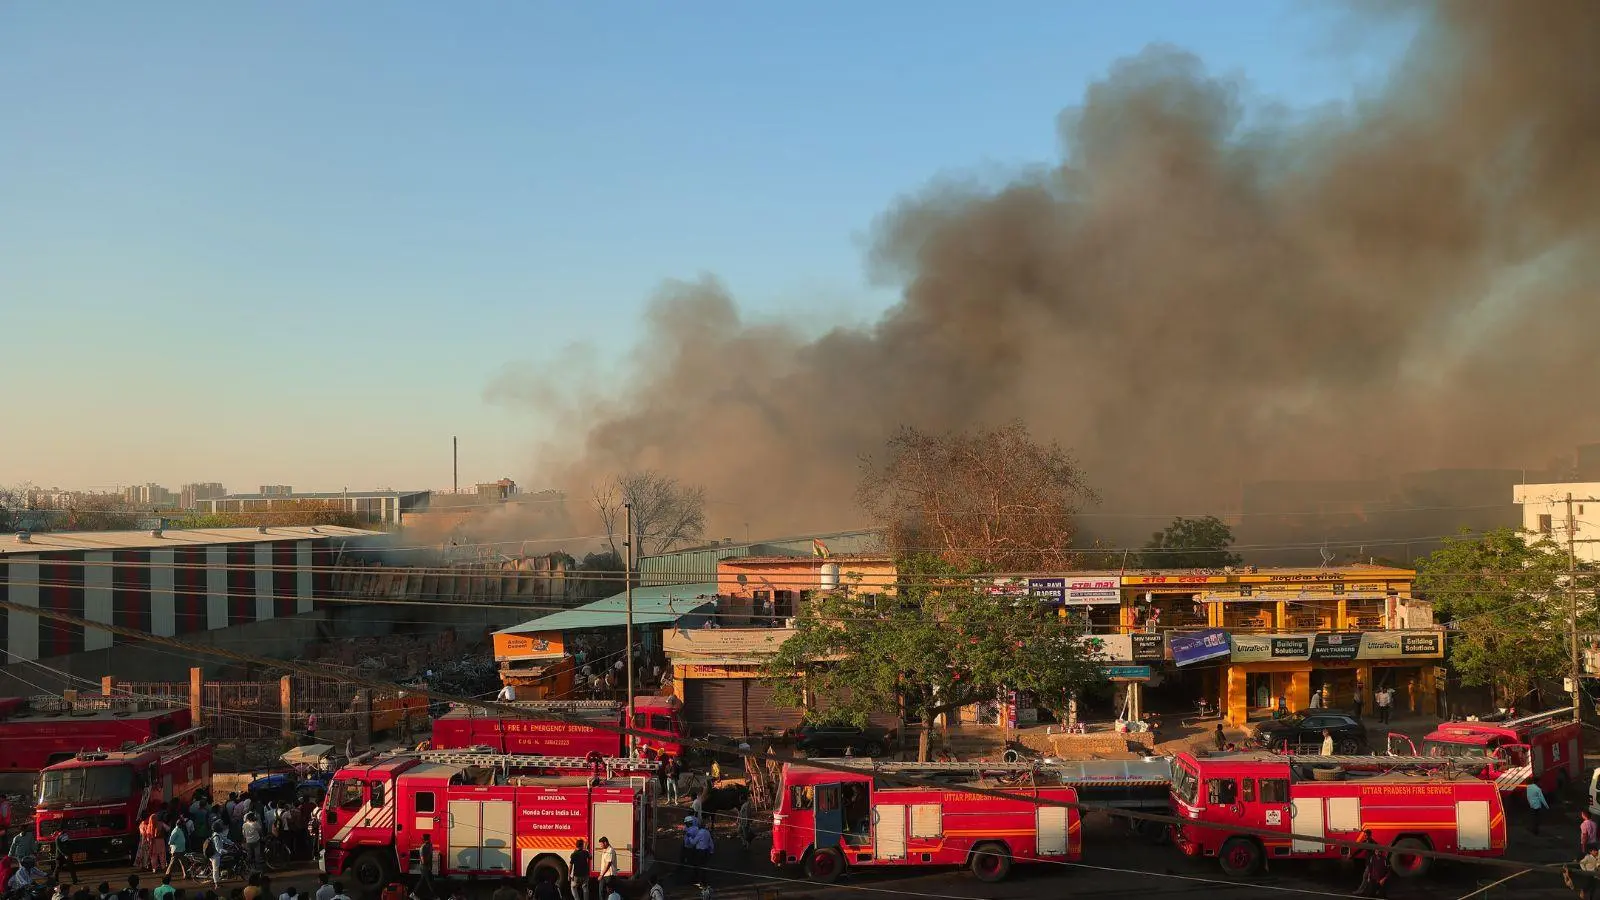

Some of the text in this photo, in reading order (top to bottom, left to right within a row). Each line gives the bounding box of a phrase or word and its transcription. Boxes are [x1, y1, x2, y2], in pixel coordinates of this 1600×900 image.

[1276, 640, 1303, 648] Building
[1367, 641, 1399, 649] UltraTech
[1406, 638, 1433, 646] Building
[1237, 644, 1269, 652] UltraTech
[1405, 644, 1435, 652] Solutions
[507, 724, 520, 732] FIRE
[530, 724, 566, 732] EMERGENCY
[568, 725, 594, 733] SERVICES
[1362, 786, 1452, 795] UTTAR PRADESH FIRE SERVICE
[944, 793, 965, 802] UTTAR
[532, 823, 554, 831] Greater
